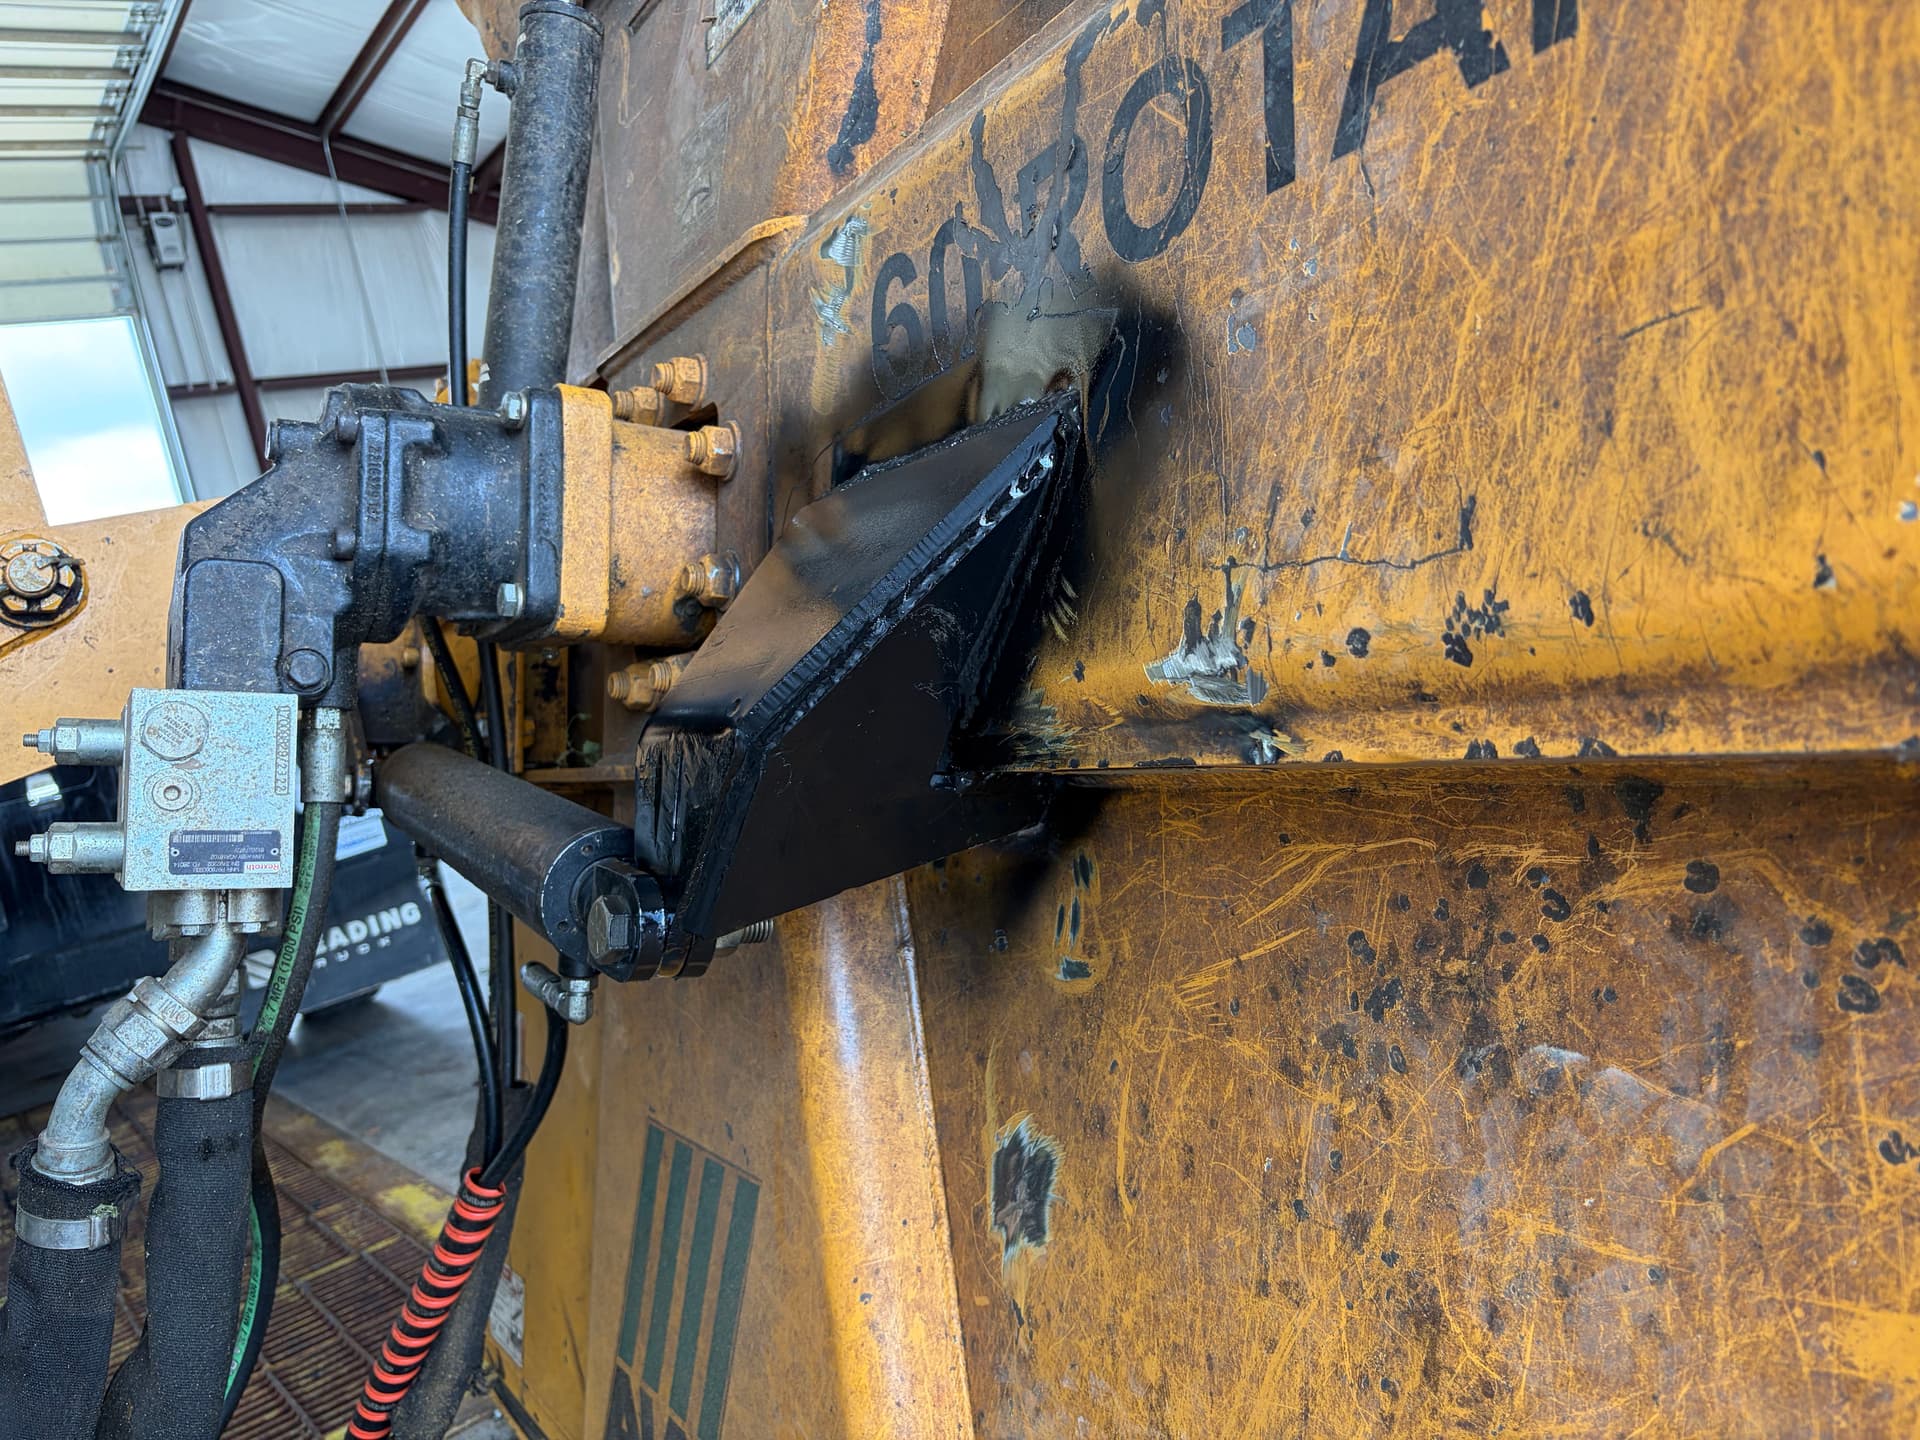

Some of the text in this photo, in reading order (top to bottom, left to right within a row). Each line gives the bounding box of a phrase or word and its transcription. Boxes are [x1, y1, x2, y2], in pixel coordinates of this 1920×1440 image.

[246, 863, 280, 871] Rexroth
[271, 975, 287, 1003] MPa
[289, 905, 306, 935] PSI)
